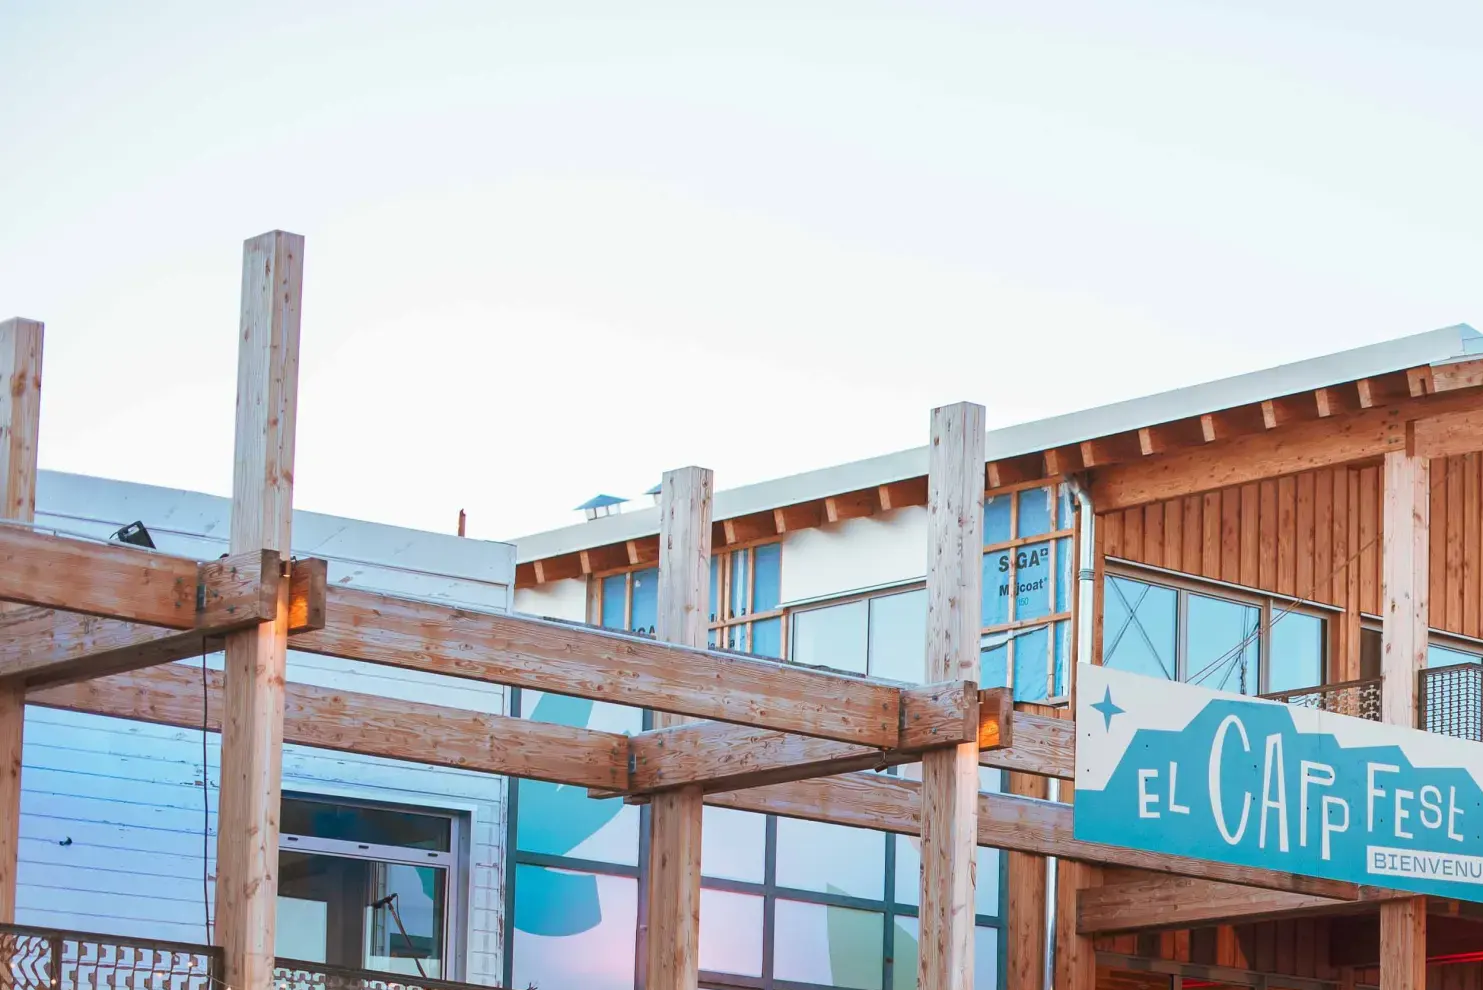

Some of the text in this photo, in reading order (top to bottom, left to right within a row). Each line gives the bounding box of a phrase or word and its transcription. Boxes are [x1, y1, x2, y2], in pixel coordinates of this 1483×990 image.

[998, 550, 1040, 572] SGA
[999, 578, 1044, 597] Mjcoat
[1137, 760, 1190, 819] EL
[1207, 713, 1350, 861] CAPP
